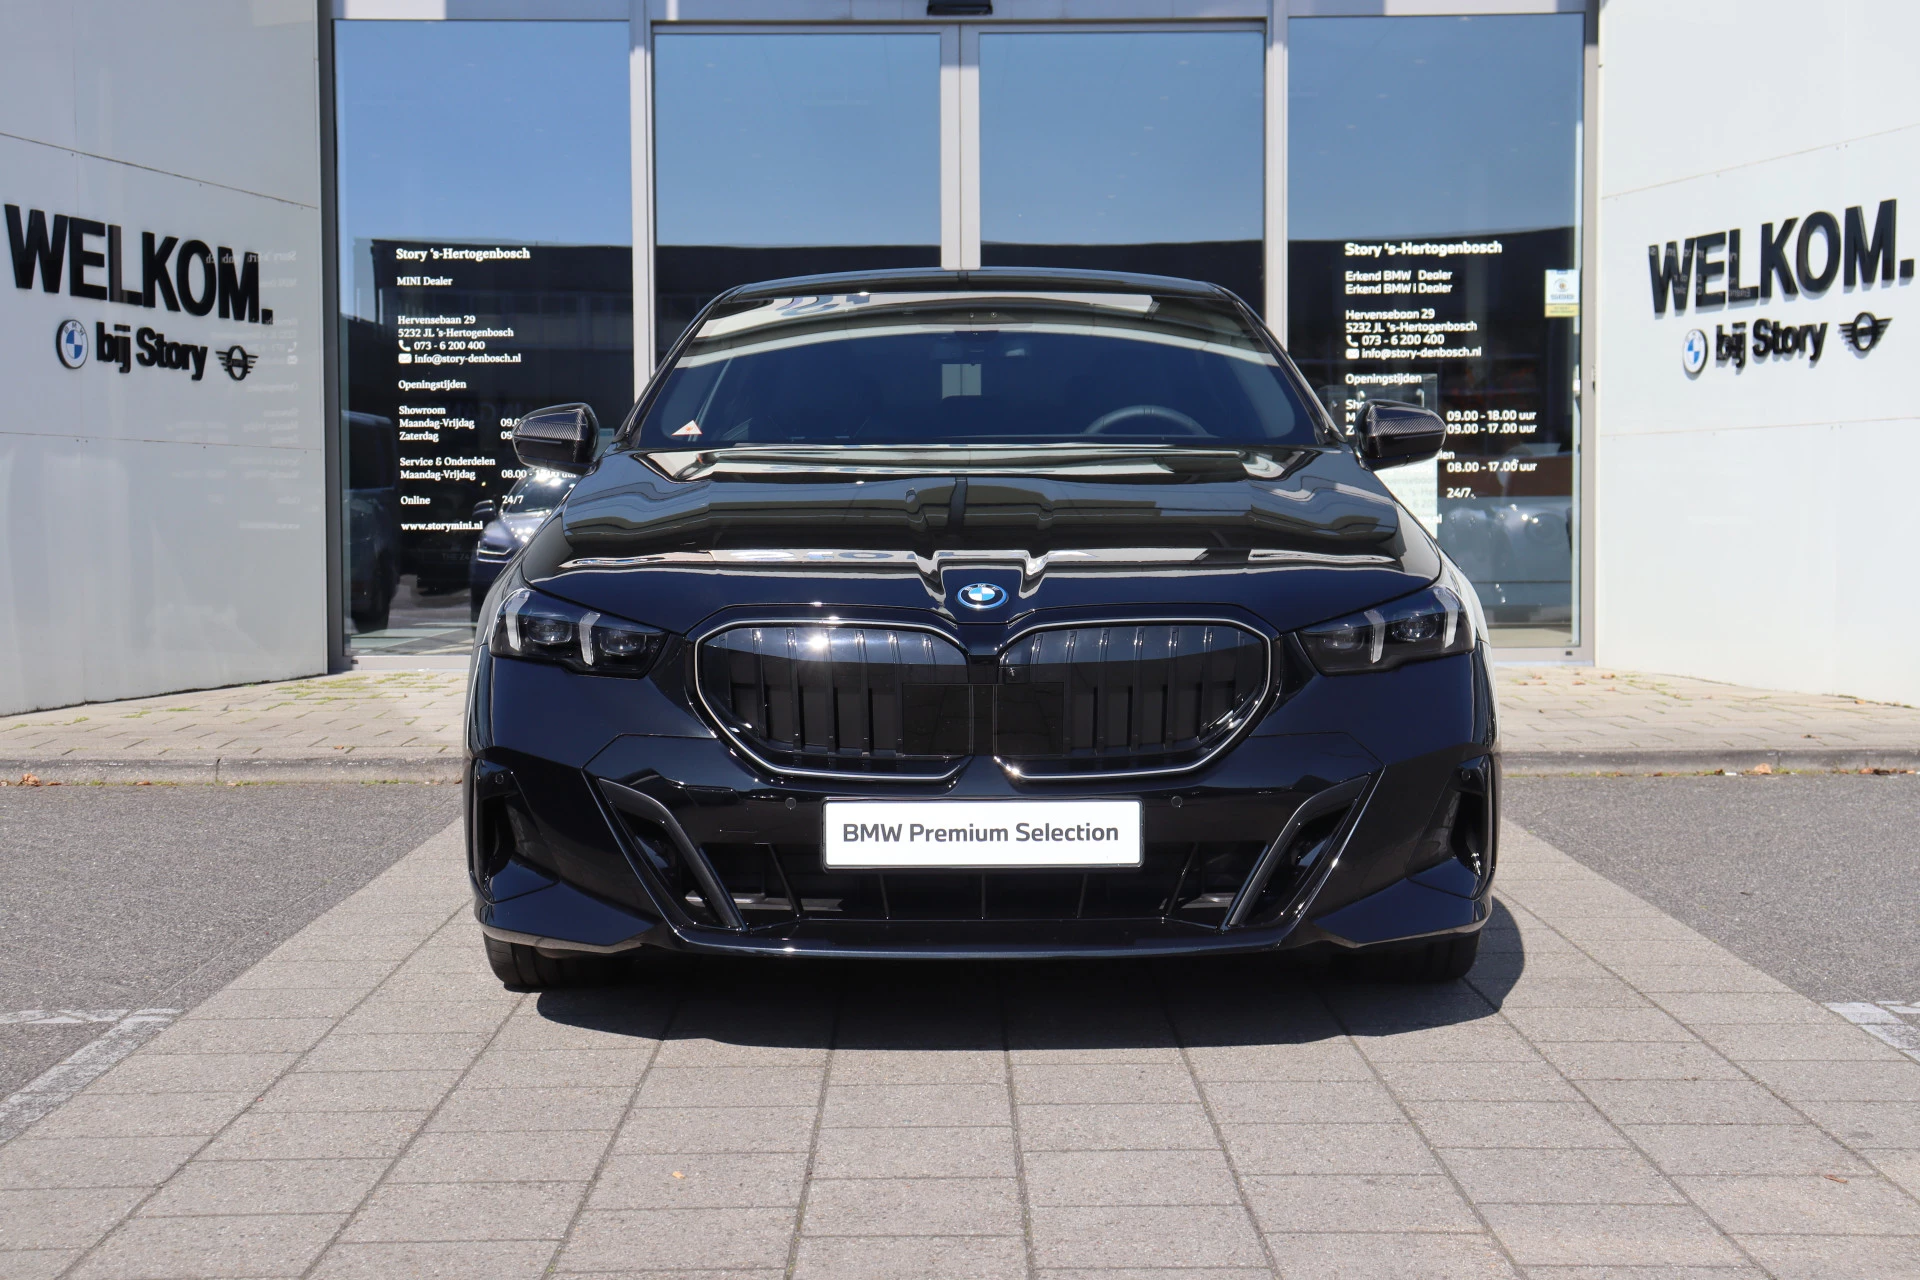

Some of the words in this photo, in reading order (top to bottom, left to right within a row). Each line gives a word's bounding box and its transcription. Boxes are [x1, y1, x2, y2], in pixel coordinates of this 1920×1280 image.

[396, 248, 427, 262] Story
[1345, 242, 1382, 258] Story
[1648, 198, 1915, 317] WELKOM.
[4, 204, 273, 325] WELKOM.
[1345, 271, 1381, 281] Erkend
[1383, 271, 1411, 281] BMW
[1418, 270, 1452, 281] Dealer
[397, 277, 421, 286] MINI
[423, 277, 453, 286] Dealer
[1345, 283, 1381, 294] Erkend
[1383, 283, 1412, 294] BMW
[1413, 283, 1416, 293] i
[1418, 283, 1452, 293] Dealer
[398, 316, 461, 324] Hervensebaan
[463, 315, 476, 324] 29
[1345, 309, 1419, 320] Hervensebaan
[1421, 309, 1435, 319] 29
[398, 329, 421, 338] 5232
[423, 329, 434, 338] JL
[1345, 323, 1371, 333] 5232
[1373, 323, 1385, 334] JL
[1362, 335, 1381, 345] 073
[1391, 335, 1398, 345] 6
[1400, 335, 1421, 345] 200
[1423, 334, 1444, 345] 400
[1716, 321, 1747, 369] bij
[1753, 318, 1828, 362] Story
[96, 321, 131, 373] bij
[136, 326, 208, 381] Story
[414, 341, 431, 350] 073
[440, 341, 446, 350] 6
[448, 341, 465, 350] 200
[467, 341, 485, 350] 400
[414, 353, 521, 365] info@story-denbosch.nl
[1362, 347, 1482, 360] info@story-denbosch.nl
[398, 380, 466, 391] Openingstijden
[1345, 374, 1422, 386] Openingstijden
[399, 406, 446, 415] Showroom
[1446, 410, 1479, 421] 09.00
[1487, 410, 1517, 421] 18.00
[1519, 411, 1537, 421] uur
[399, 419, 475, 429] Maandag-Vrijdag
[1446, 424, 1479, 435] 09.00
[1487, 423, 1517, 434] 17.00
[1519, 424, 1537, 434] uur
[399, 432, 439, 442] Zaterdag
[400, 457, 433, 466] Service
[436, 457, 442, 466] &
[444, 457, 495, 466] Onderdelen
[1446, 462, 1479, 473] 08.00
[1488, 462, 1518, 473] 17.00
[1519, 463, 1537, 472] uur
[400, 470, 476, 480] Maandag-Vrijdag
[501, 470, 527, 478] 08.00
[400, 496, 431, 505] Online
[502, 496, 524, 504] 24/7
[401, 521, 484, 532] www.storymini.nl
[842, 823, 902, 842] BMW
[909, 823, 1009, 842] Premium
[1015, 822, 1119, 841] Selection
